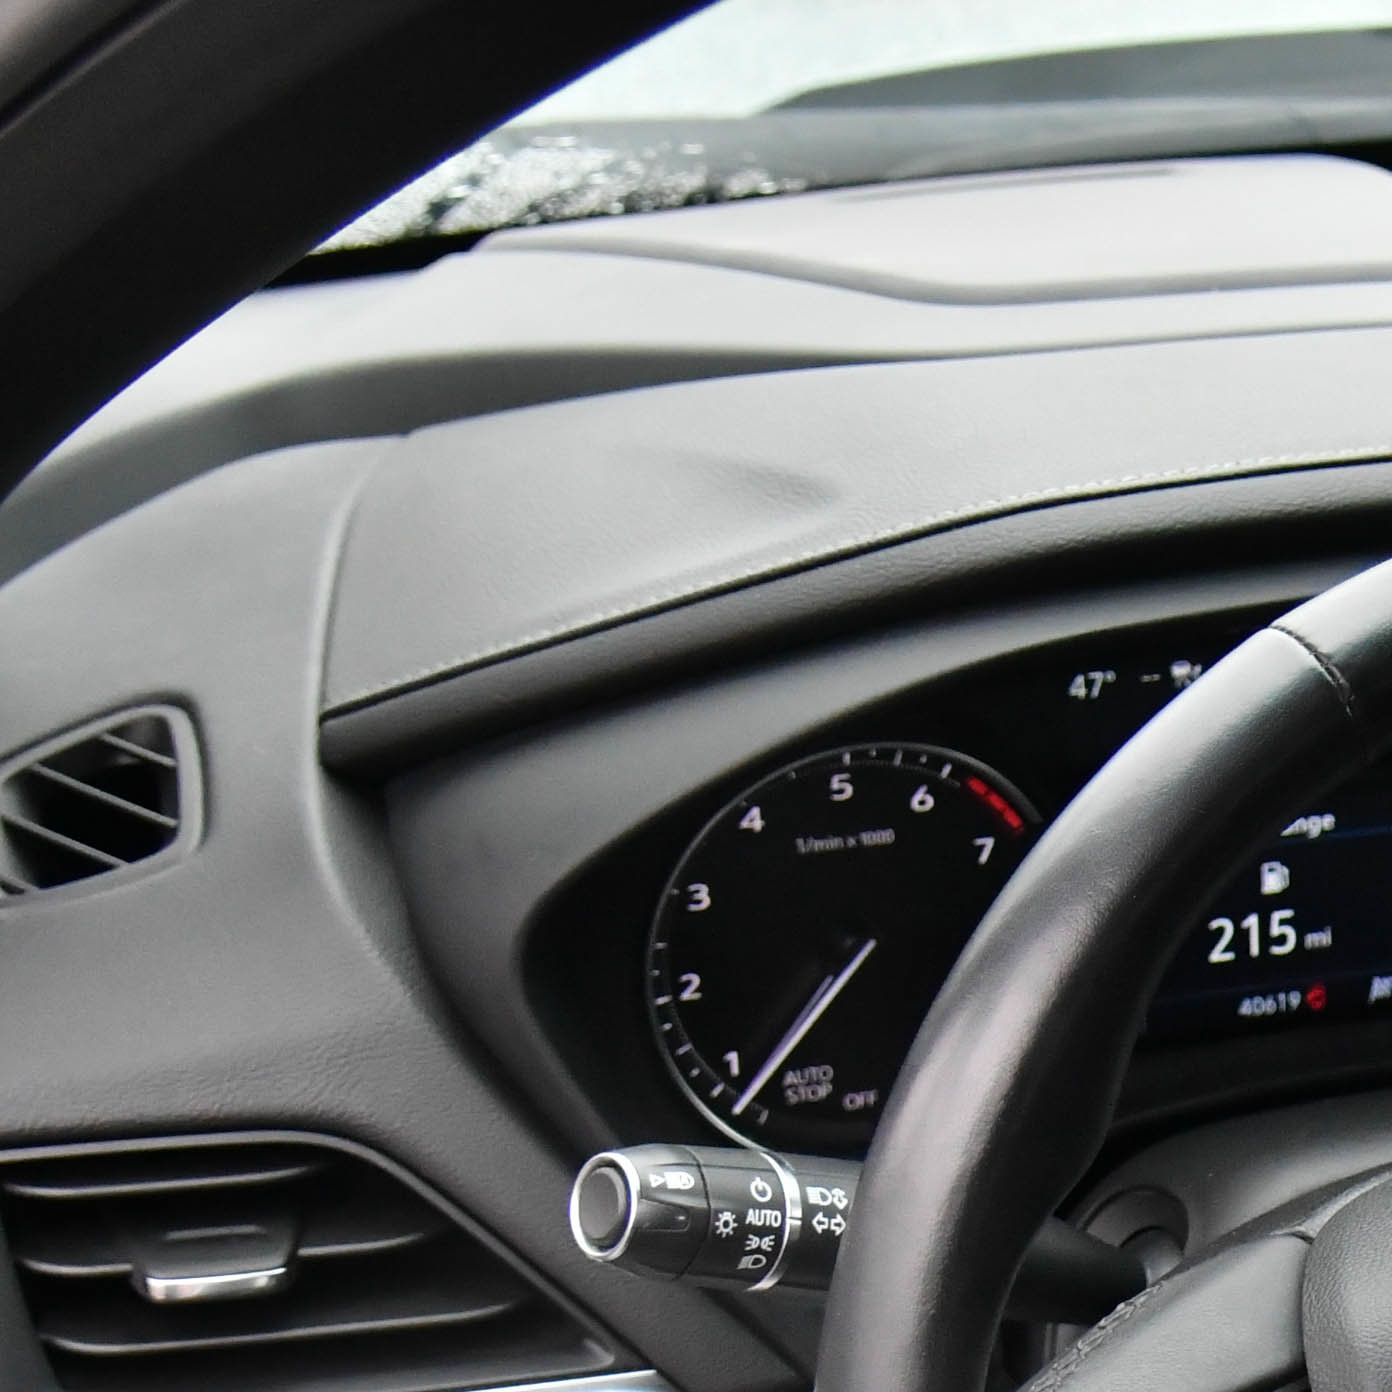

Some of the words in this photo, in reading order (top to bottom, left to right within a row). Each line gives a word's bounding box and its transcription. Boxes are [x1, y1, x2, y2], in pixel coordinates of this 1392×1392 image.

[830, 773, 854, 801] 5
[910, 785, 935, 813] 6
[739, 806, 765, 833] 4
[972, 836, 996, 864] 7
[686, 883, 711, 911] 3
[1208, 909, 1297, 963] 215
[679, 973, 702, 1001] 2
[723, 1050, 740, 1077] 1
[783, 1065, 834, 1087] AUTO
[784, 1082, 833, 1106] STOP
[842, 1090, 879, 1111] OFF
[745, 1209, 782, 1228] AUTO
